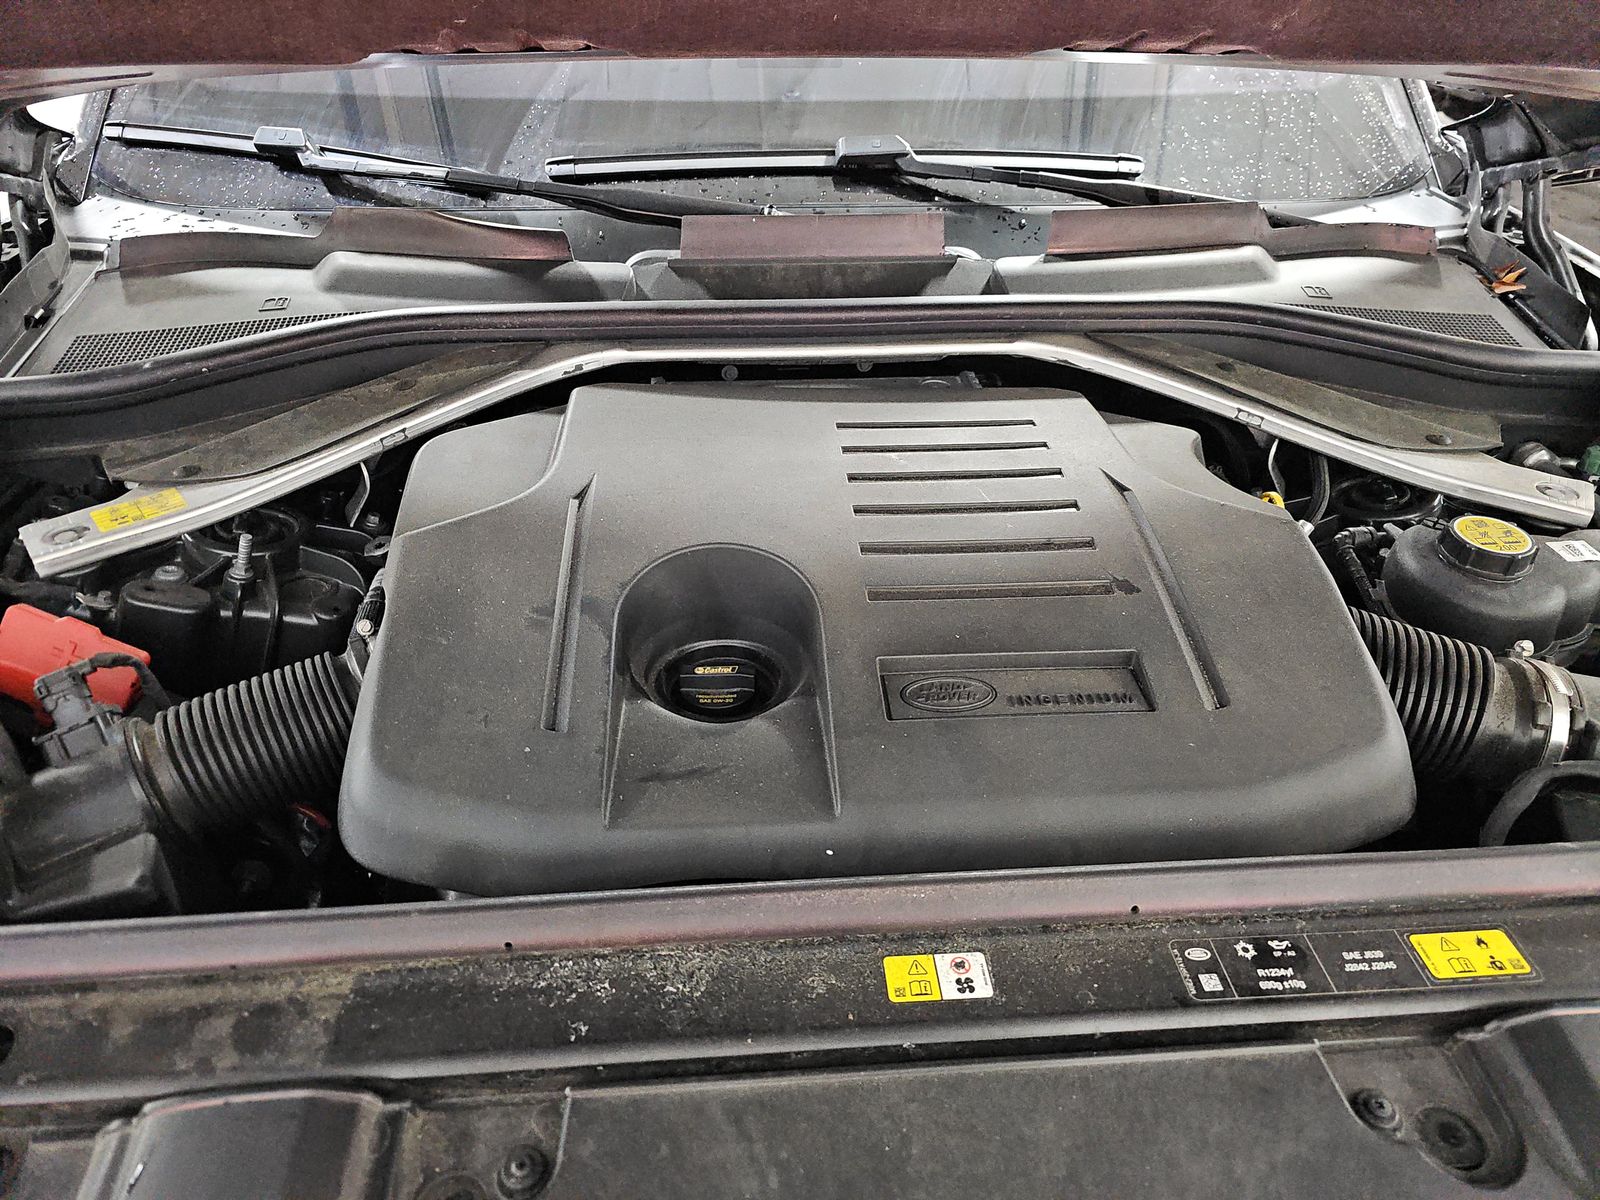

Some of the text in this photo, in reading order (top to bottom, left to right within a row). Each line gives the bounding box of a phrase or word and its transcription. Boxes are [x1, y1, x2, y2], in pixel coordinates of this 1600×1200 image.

[704, 666, 733, 674] Castrol
[1007, 692, 1134, 706] INGENIUM
[1341, 951, 1363, 960] SAE
[1256, 967, 1294, 978] R1234yf
